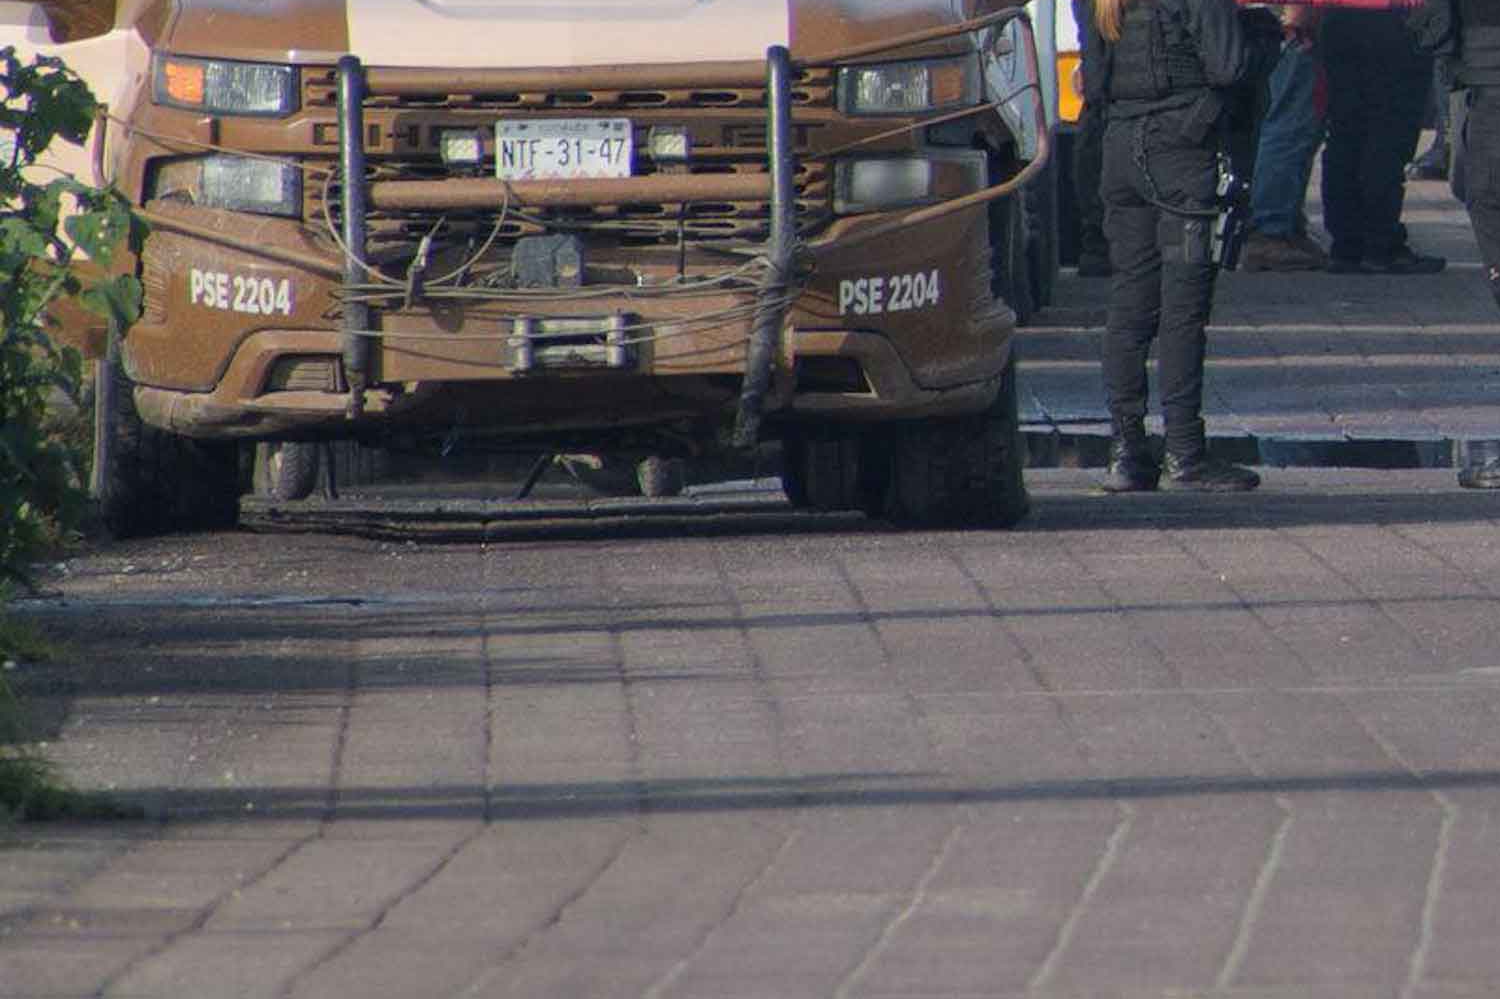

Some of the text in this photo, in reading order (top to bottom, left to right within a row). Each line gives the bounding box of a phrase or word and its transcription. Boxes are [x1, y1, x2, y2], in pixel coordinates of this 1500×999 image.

[502, 138, 625, 168] NTF-31-47
[191, 268, 291, 315] PSE 2204
[839, 268, 940, 316] PSE 2204
